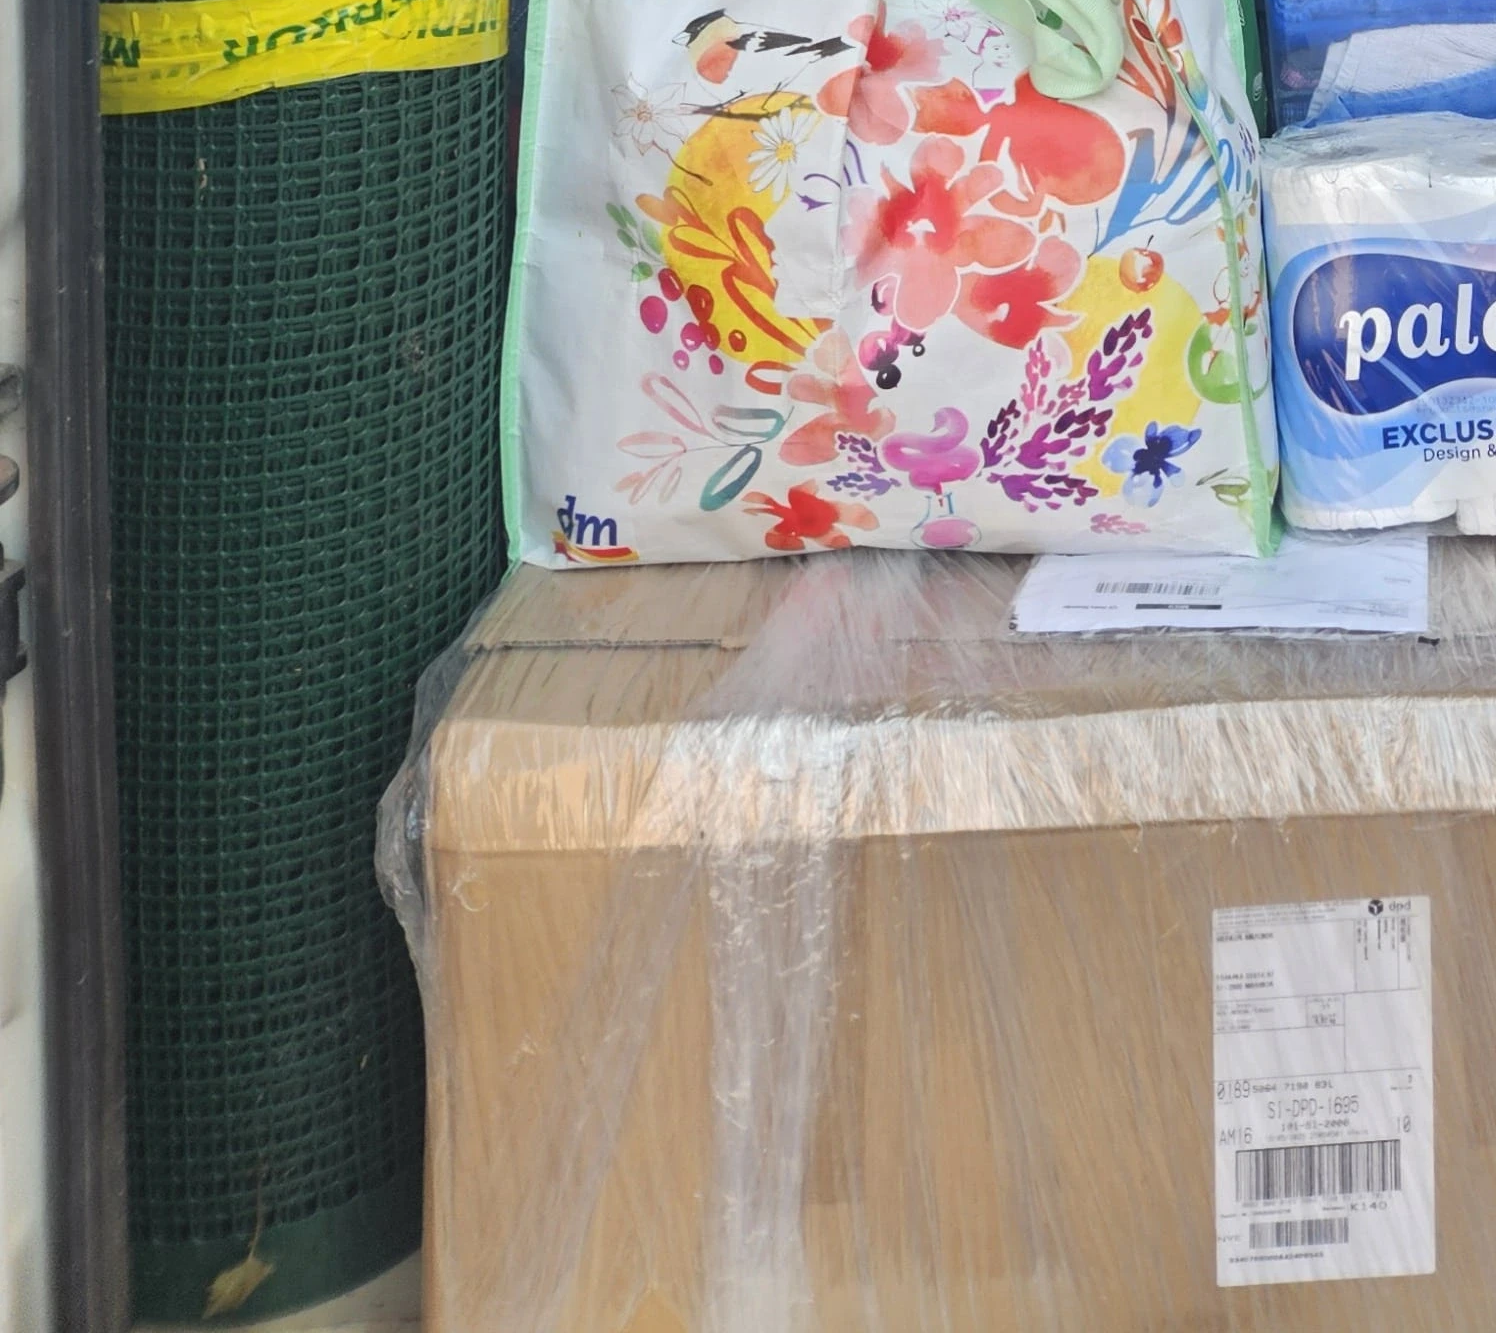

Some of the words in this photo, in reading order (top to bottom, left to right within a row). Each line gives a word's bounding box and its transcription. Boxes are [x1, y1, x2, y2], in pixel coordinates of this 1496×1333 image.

[1423, 446, 1481, 463] Design
[556, 495, 618, 547] dm
[1388, 899, 1412, 915] dpd
